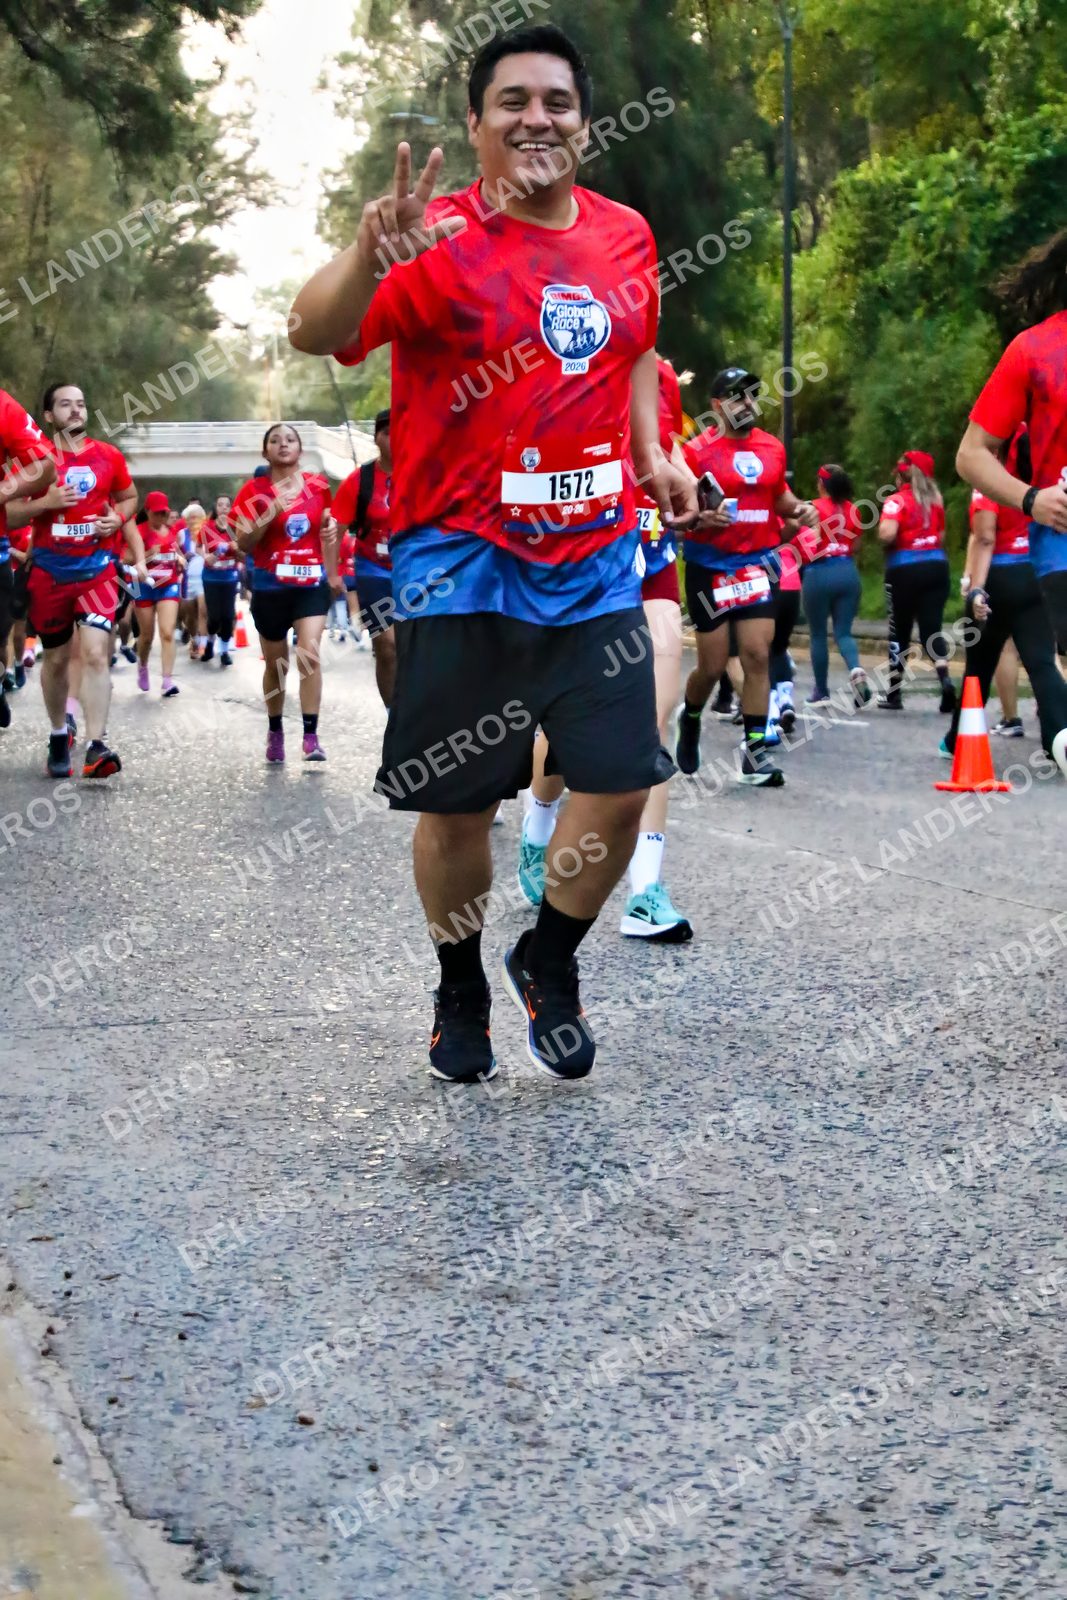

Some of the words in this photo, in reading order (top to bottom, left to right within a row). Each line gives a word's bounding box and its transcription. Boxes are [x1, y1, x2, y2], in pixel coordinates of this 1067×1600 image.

[557, 305, 591, 318] Global
[551, 318, 580, 330] Race
[565, 361, 587, 372] 2026
[549, 469, 594, 501] 1572
